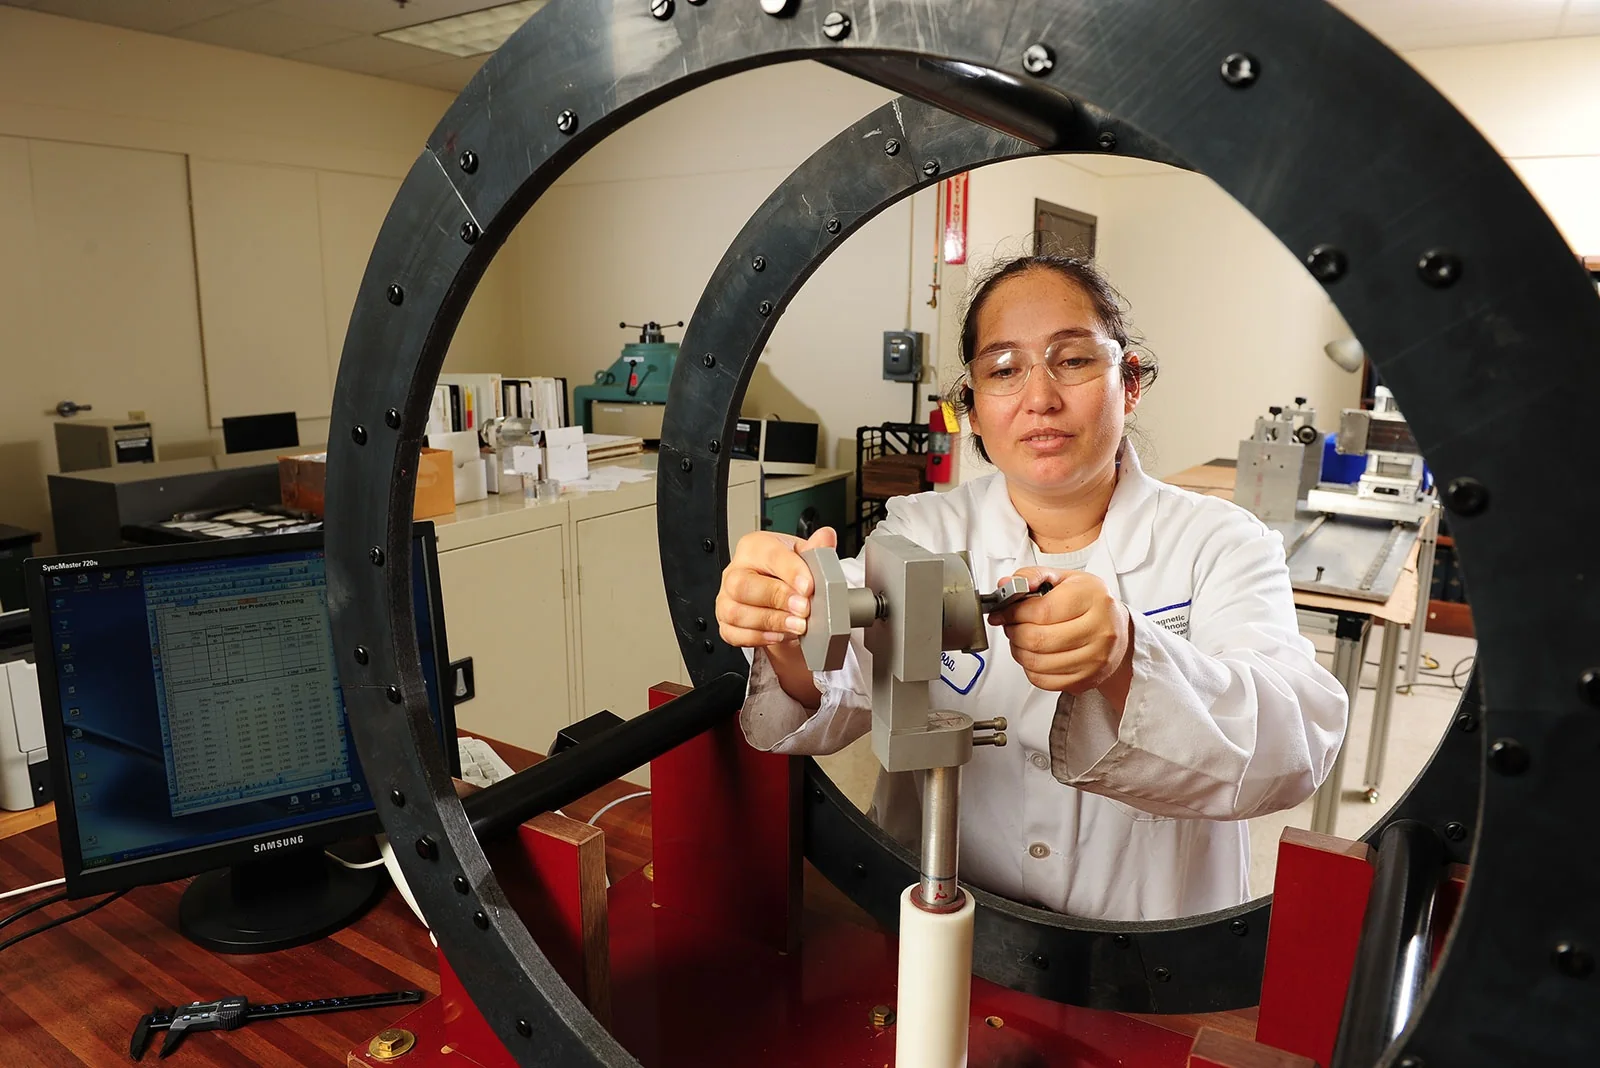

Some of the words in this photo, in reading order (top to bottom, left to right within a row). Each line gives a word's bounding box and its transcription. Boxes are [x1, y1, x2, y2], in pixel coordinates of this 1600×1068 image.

[42, 562, 81, 572] SyncMaster
[188, 608, 218, 616] Magnetics
[248, 601, 279, 609] Production
[280, 598, 304, 606] Tracking
[1153, 615, 1185, 625] agnetic
[940, 652, 955, 672] osa
[253, 835, 304, 853] SAMSUNG
